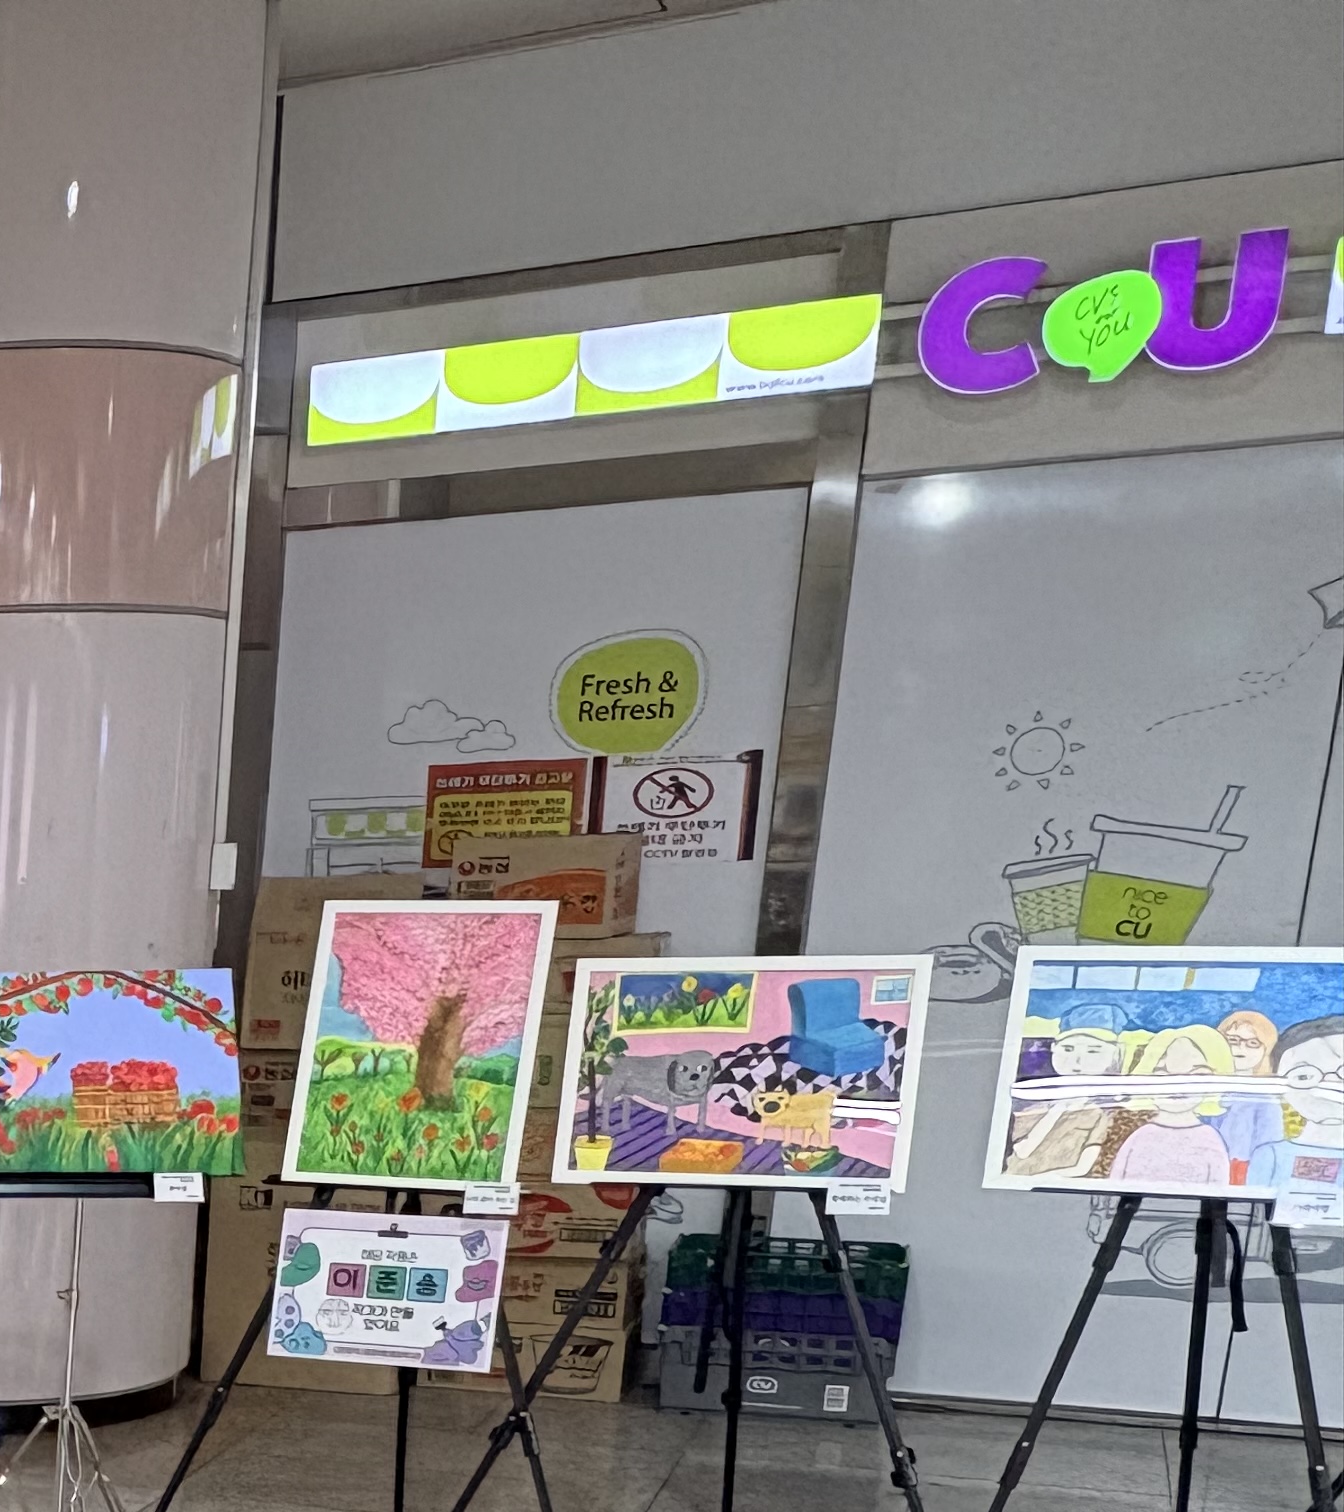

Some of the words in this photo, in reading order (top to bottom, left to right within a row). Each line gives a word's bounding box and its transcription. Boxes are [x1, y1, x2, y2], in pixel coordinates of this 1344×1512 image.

[918, 226, 1290, 395] CU
[1079, 314, 1131, 355] YOU
[580, 671, 652, 697] Fresh
[658, 670, 679, 693] &
[578, 697, 675, 722] Refresh
[1127, 903, 1152, 921] to
[1115, 919, 1153, 940] CU
